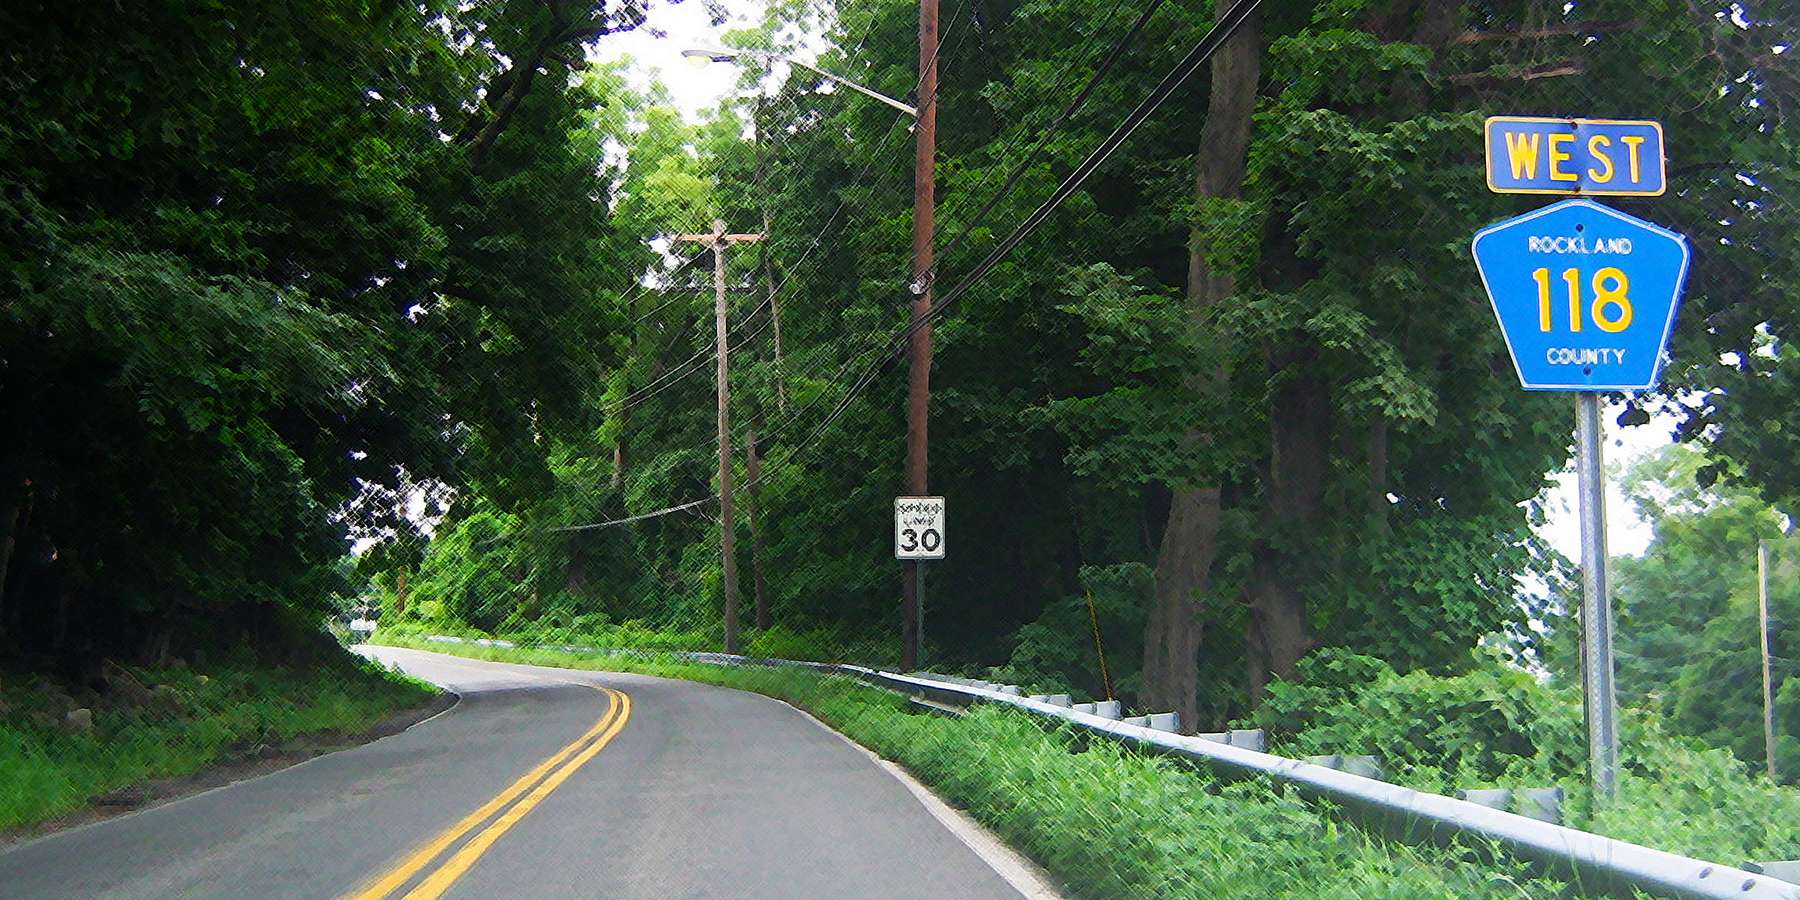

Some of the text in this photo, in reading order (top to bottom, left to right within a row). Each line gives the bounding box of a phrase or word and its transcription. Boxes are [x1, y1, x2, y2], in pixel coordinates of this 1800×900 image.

[1505, 132, 1645, 183] WEST
[1528, 236, 1632, 254] ROCKLAND
[1532, 267, 1633, 332] 118
[1546, 348, 1625, 365] COUNTY
[901, 528, 941, 552] 30
